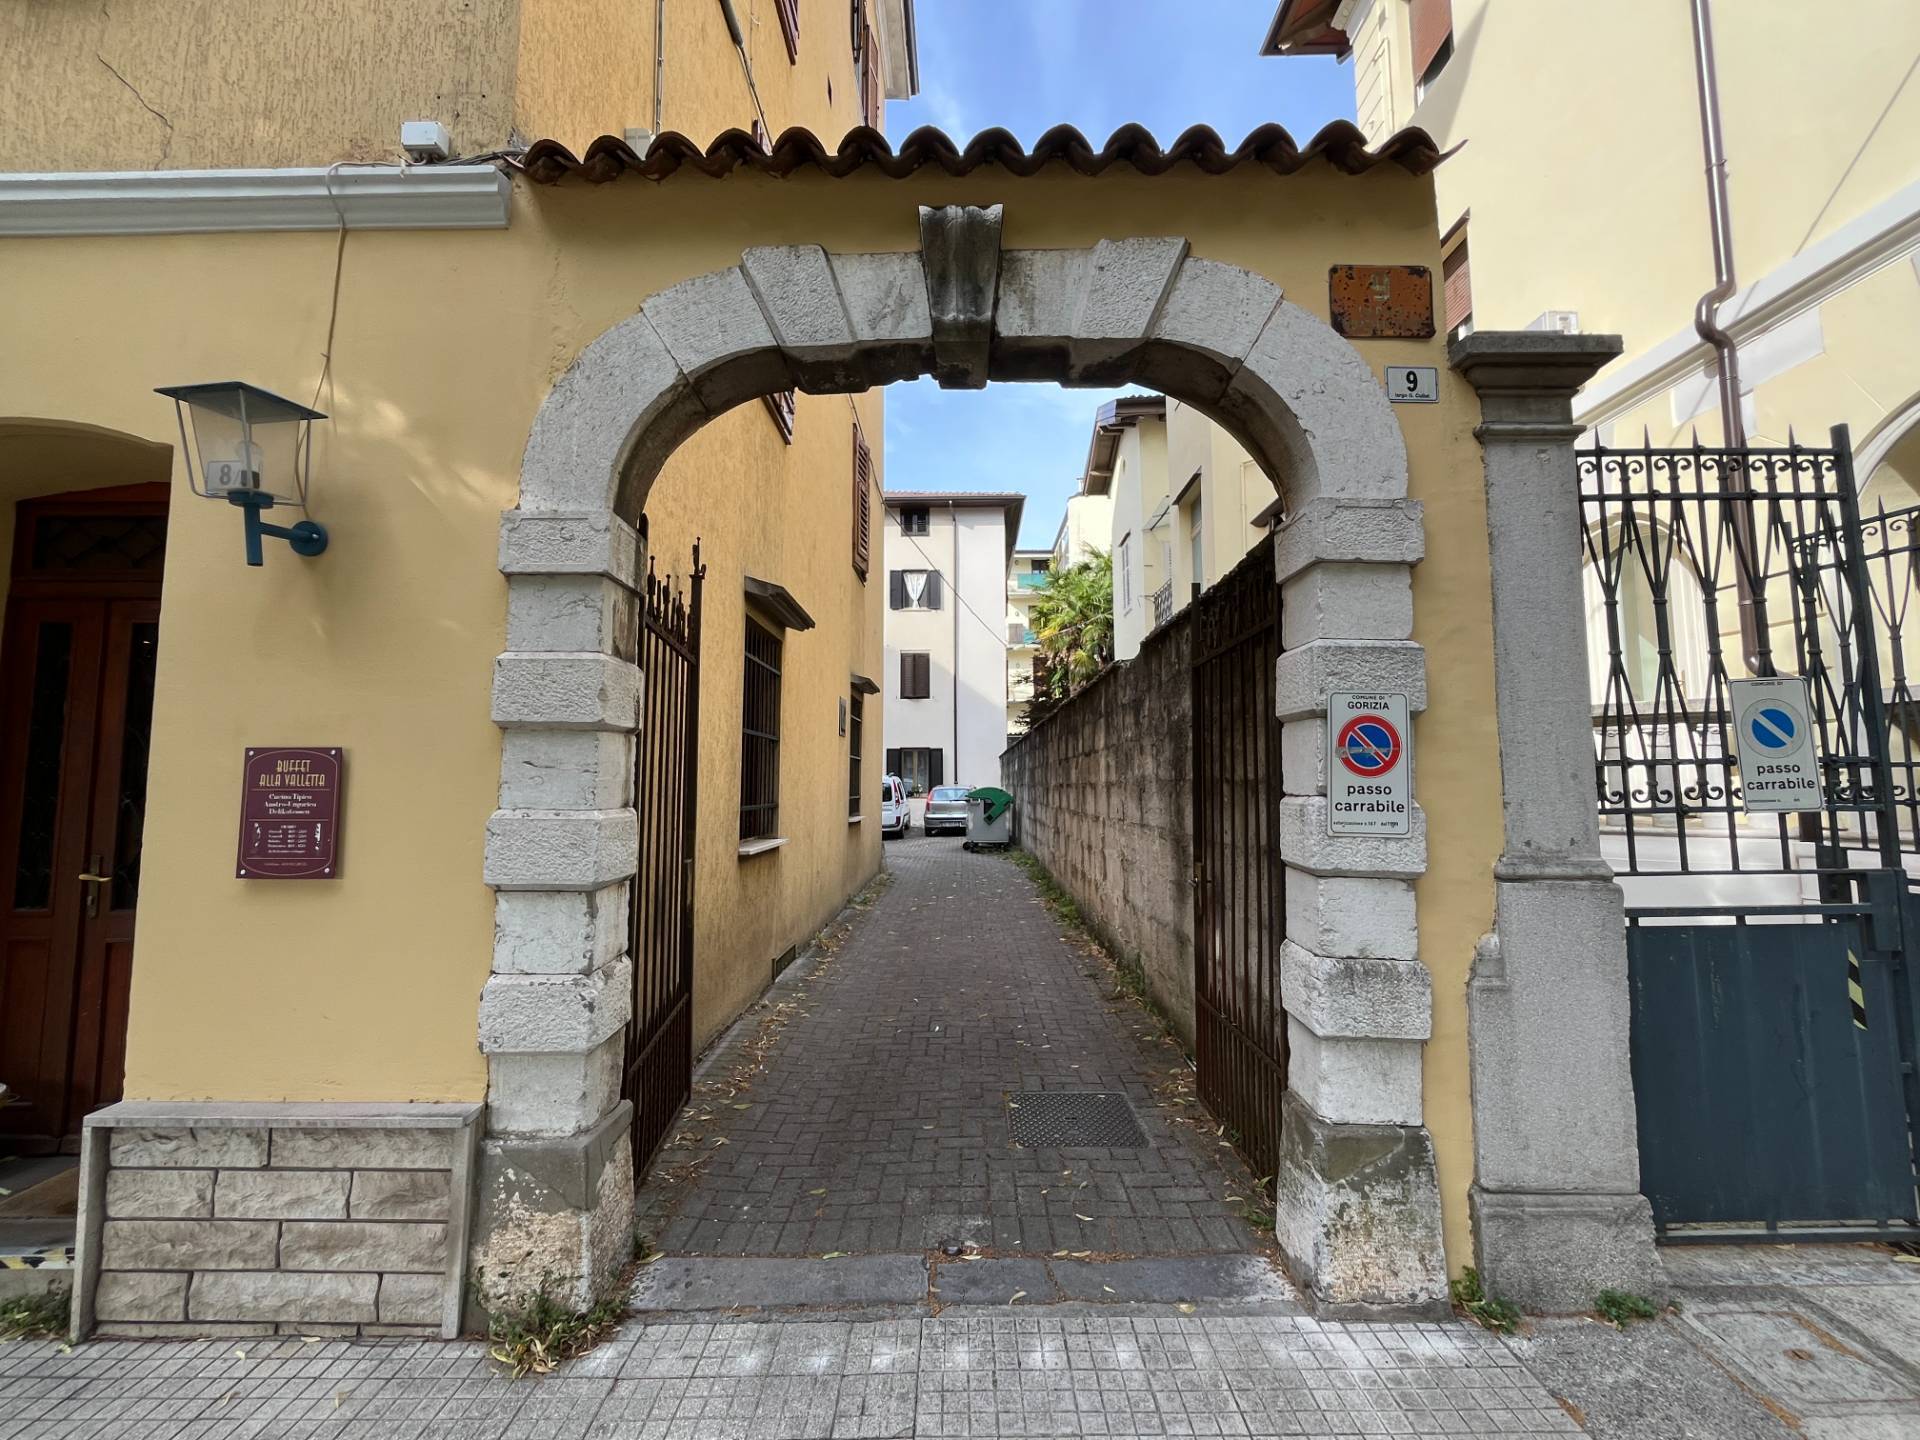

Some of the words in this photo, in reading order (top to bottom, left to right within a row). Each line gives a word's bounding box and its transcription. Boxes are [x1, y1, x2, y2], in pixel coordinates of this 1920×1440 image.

[1405, 370, 1418, 392] 9
[1347, 701, 1390, 710] GORIZIA
[276, 759, 312, 773] BUFFET
[1757, 764, 1801, 776] passo
[259, 773, 281, 787] ALLA
[284, 773, 326, 787] VALLETTA
[1747, 778, 1816, 790] carrabile
[1347, 785, 1392, 796] passo
[1335, 800, 1405, 813] carrabile
